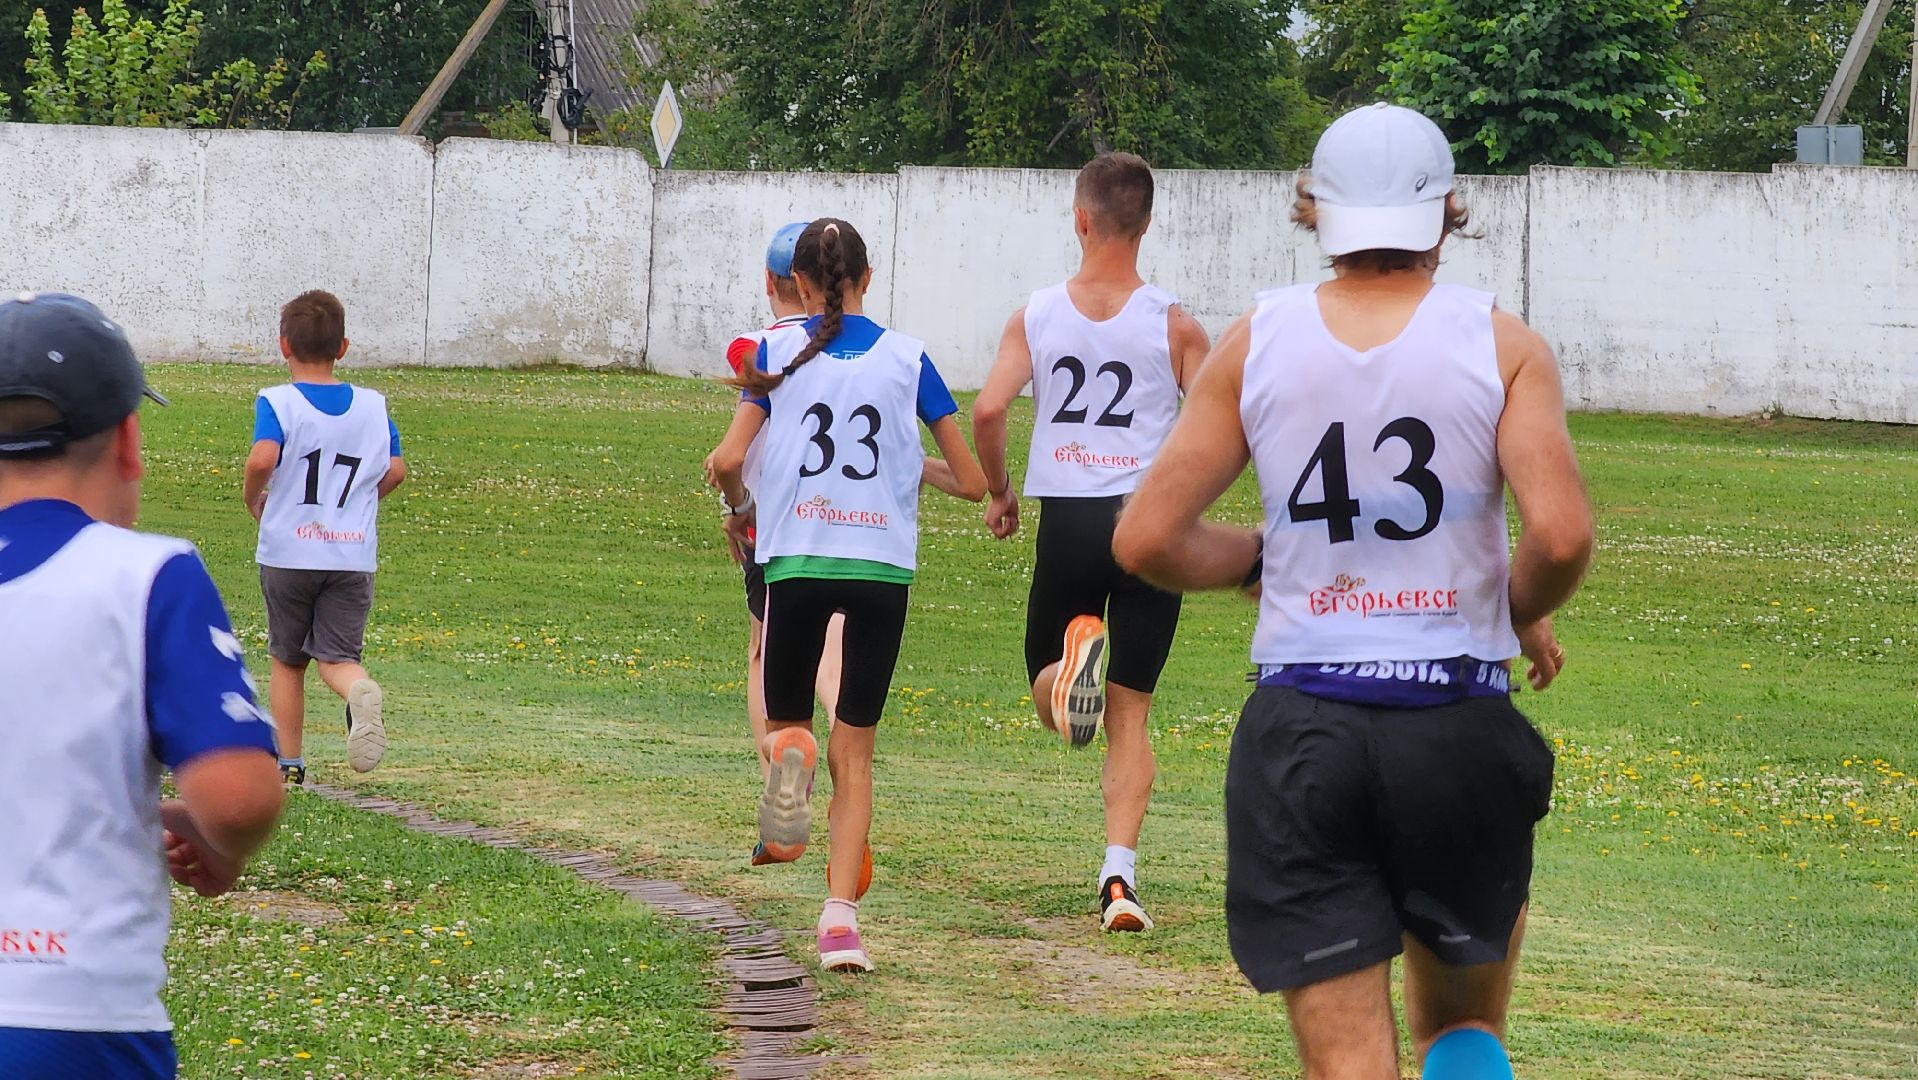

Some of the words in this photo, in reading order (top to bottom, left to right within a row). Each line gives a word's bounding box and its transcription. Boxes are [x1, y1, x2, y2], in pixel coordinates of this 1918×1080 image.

[1050, 355, 1136, 429] 22
[296, 447, 363, 509] 17
[798, 402, 882, 481] 33
[1287, 416, 1444, 544] 43
[1309, 588, 1459, 618] Егорьевск
